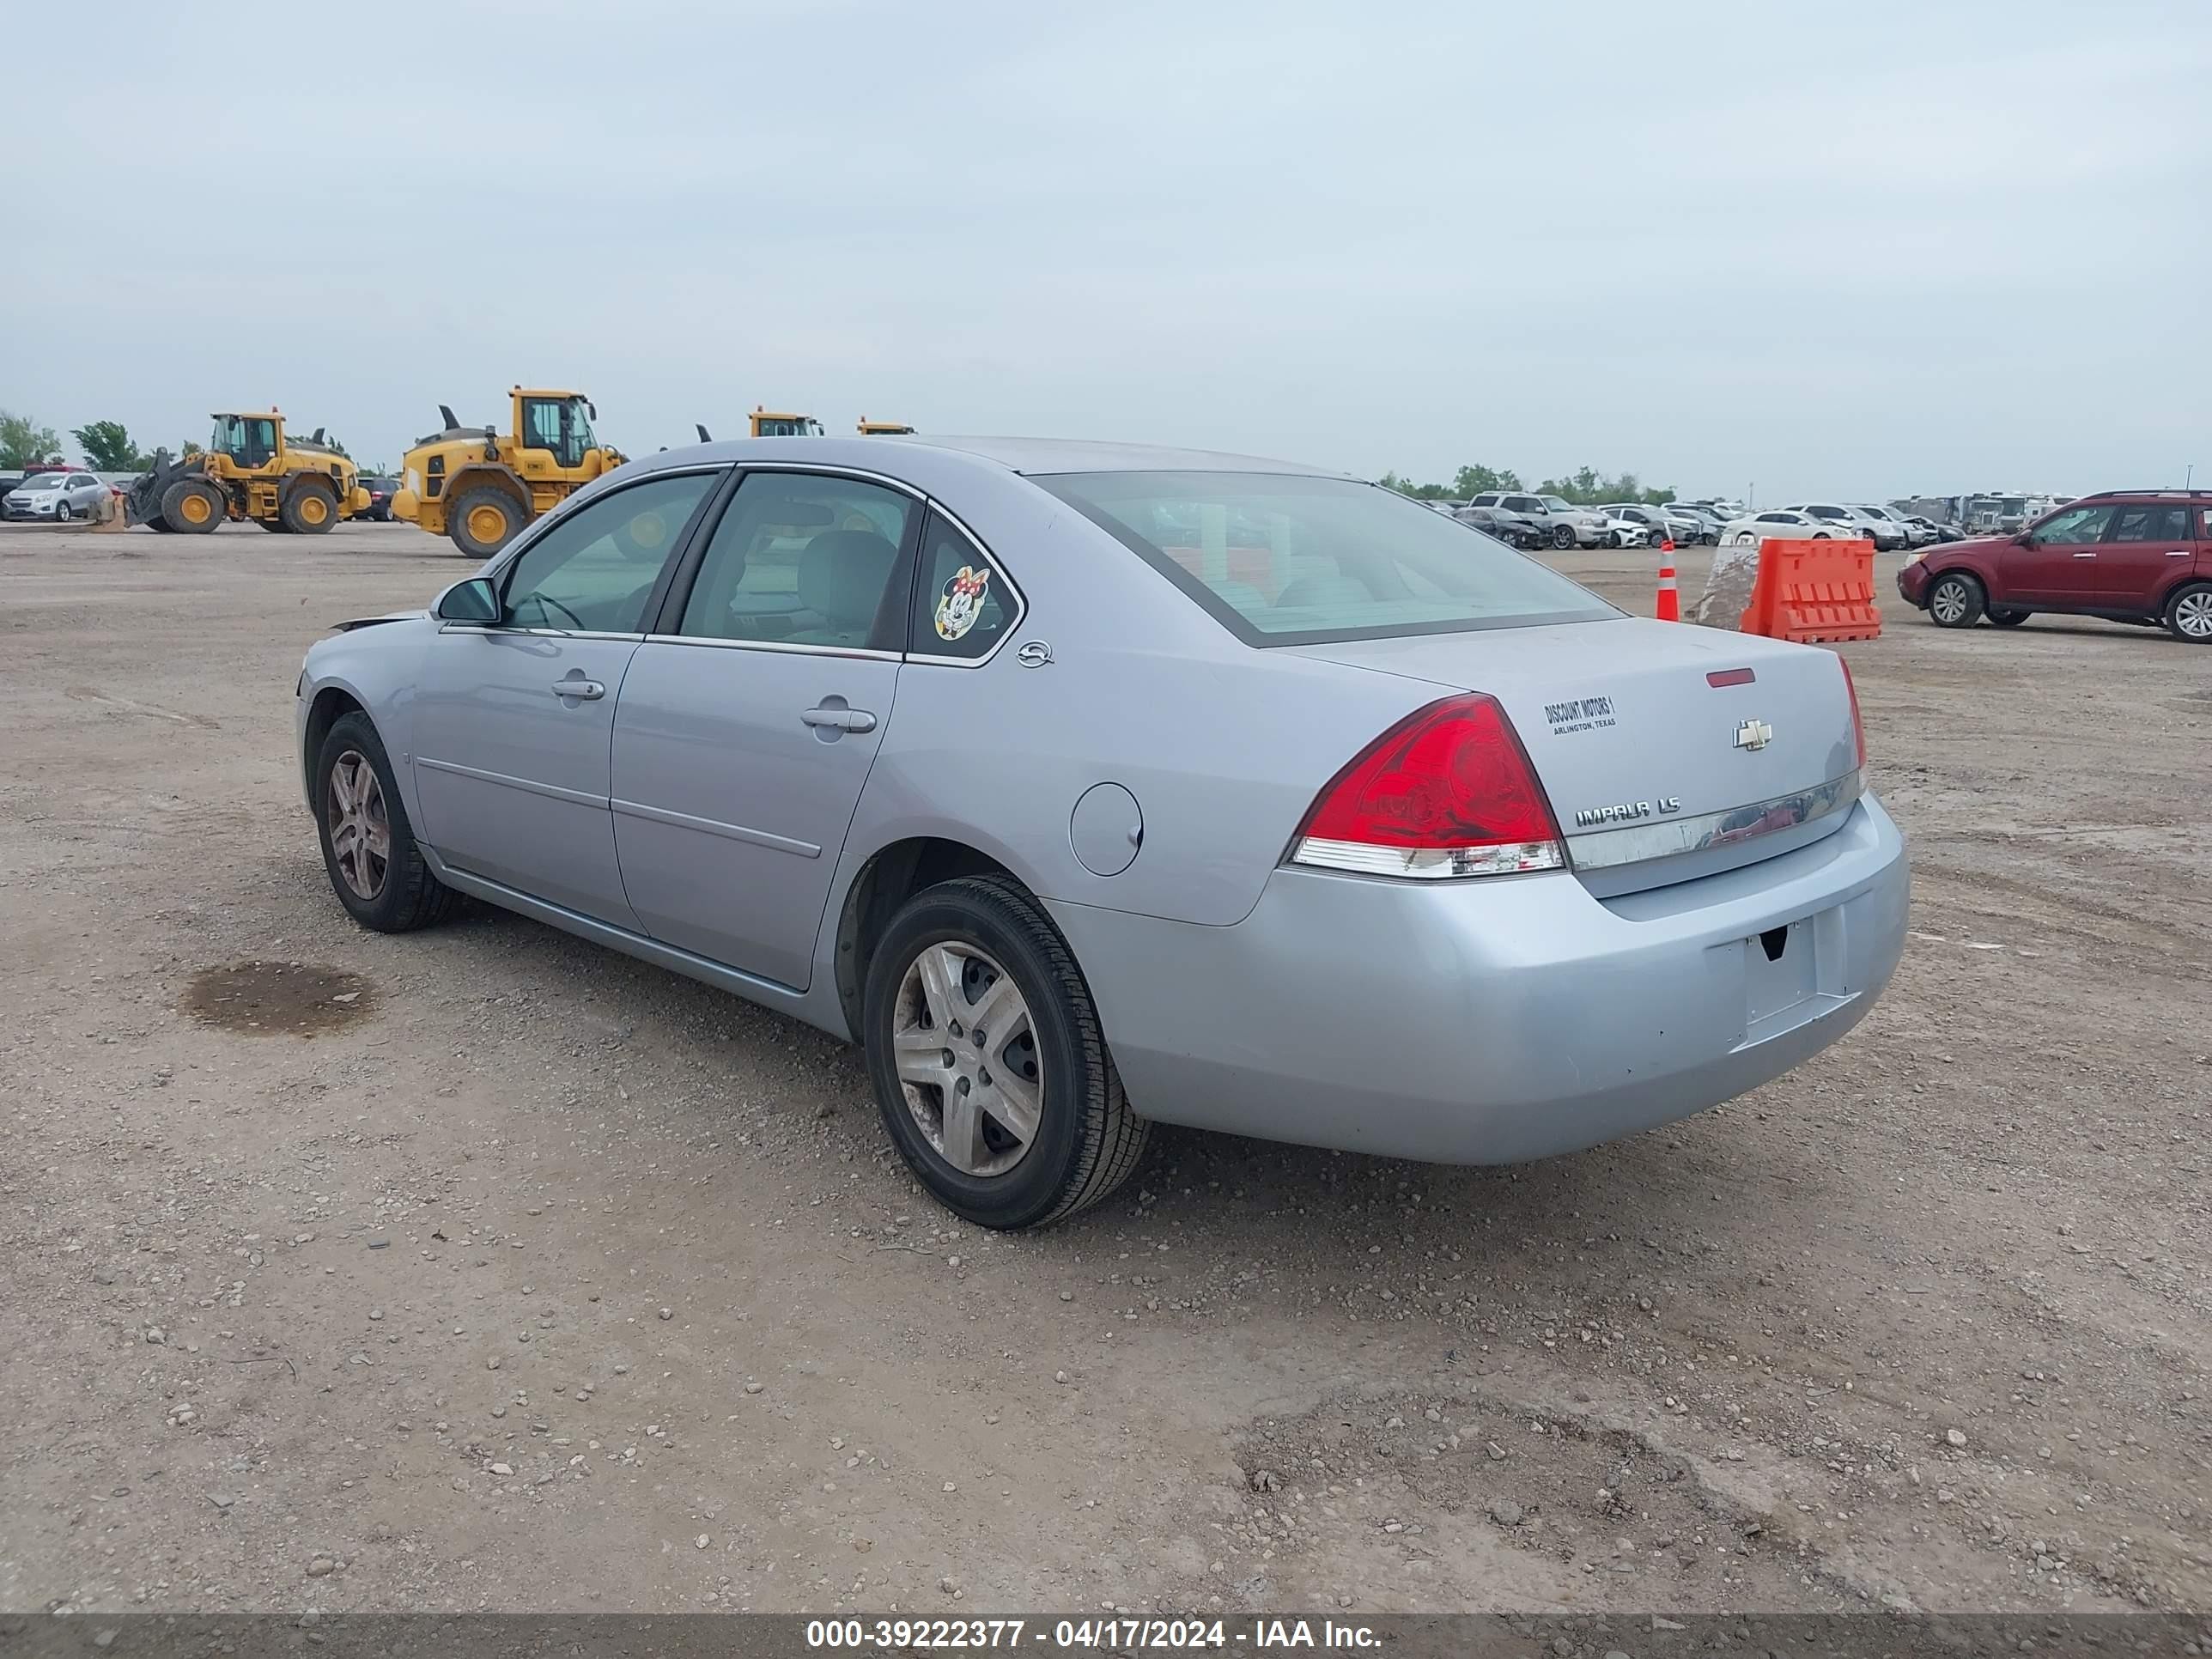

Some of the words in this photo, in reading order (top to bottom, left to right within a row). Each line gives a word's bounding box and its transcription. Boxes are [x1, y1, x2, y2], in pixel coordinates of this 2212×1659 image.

[1544, 700, 1583, 725] DISCOUNT
[1580, 696, 1611, 719] MOTORS
[1553, 721, 1595, 736] ARLINGTON,
[1594, 718, 1617, 729] TEXAS
[1576, 800, 1650, 827] IMPALA
[1657, 796, 1681, 814] LS
